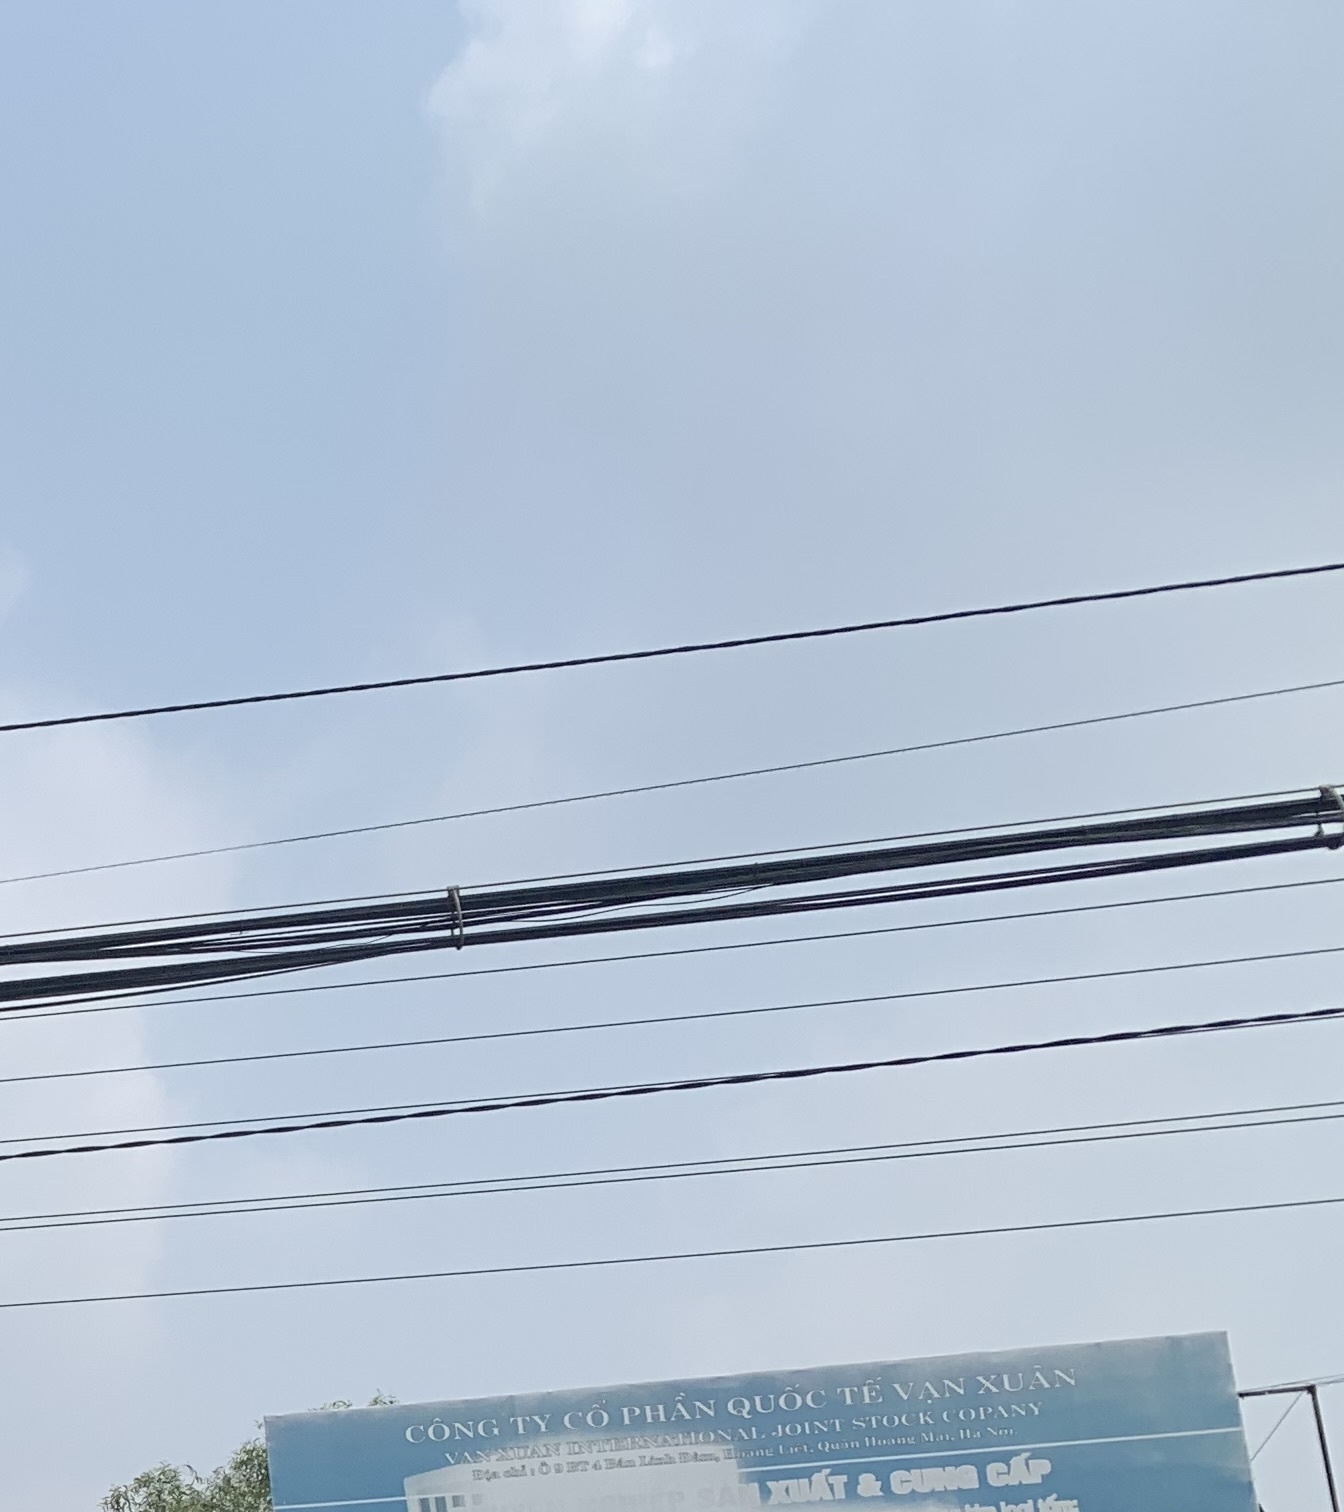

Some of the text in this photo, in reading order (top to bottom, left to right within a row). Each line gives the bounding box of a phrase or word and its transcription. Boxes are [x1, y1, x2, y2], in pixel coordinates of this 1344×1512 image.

[403, 1363, 1077, 1444] CÔNG TY CỔ PHẦN QUỐC TẾ VẠN XUÂN
[445, 1401, 1043, 1464] VAN XUAN INTERNATIONAL JOINT STOCK COPANY
[765, 1466, 850, 1504] XUẤT
[854, 1471, 884, 1497] &
[888, 1463, 980, 1494] CUNG
[983, 1449, 1054, 1487] CẤP
